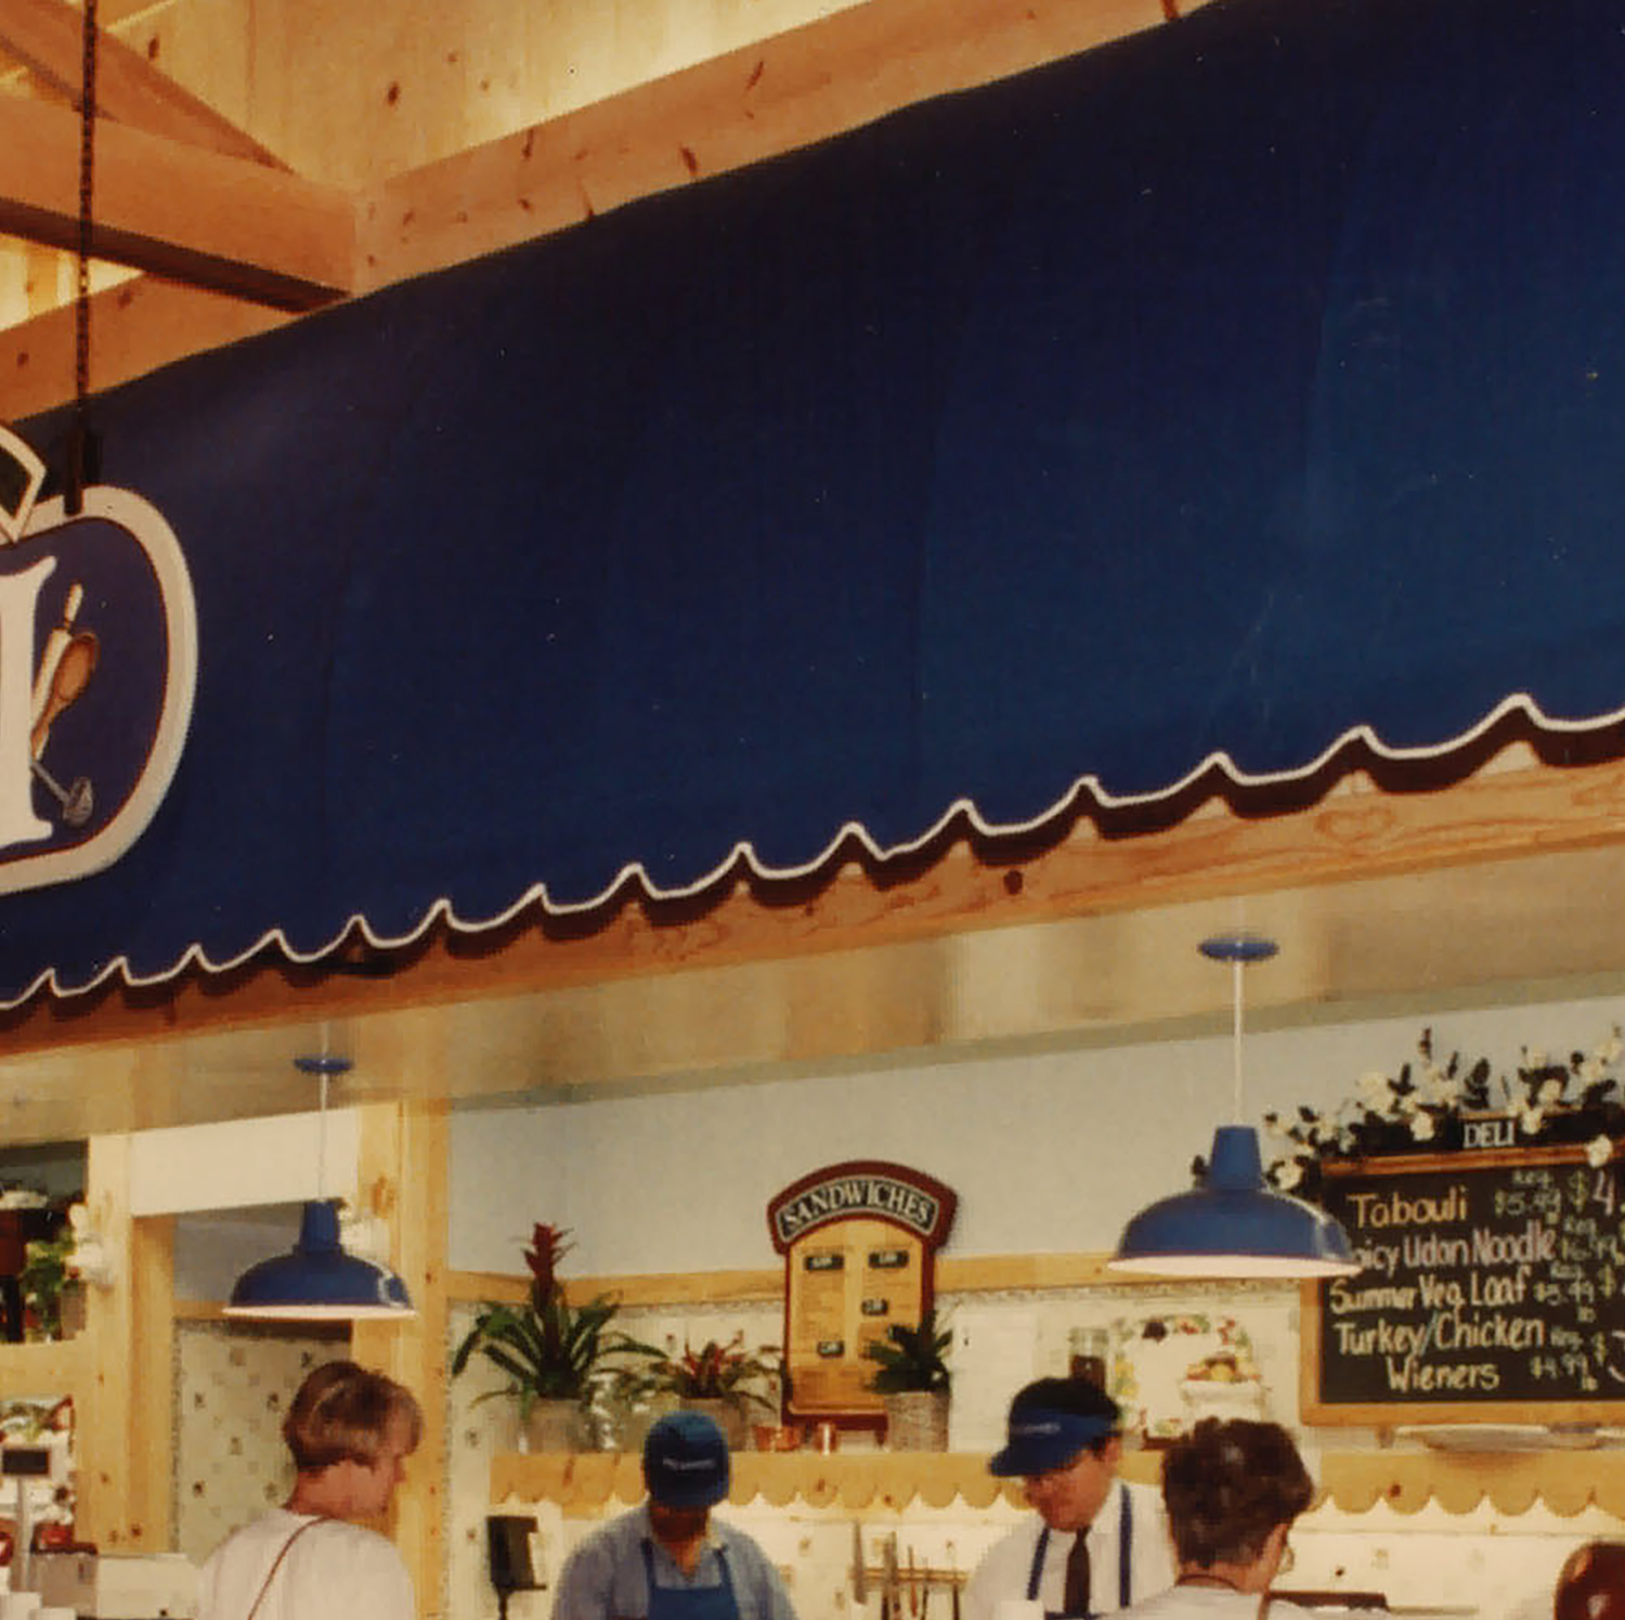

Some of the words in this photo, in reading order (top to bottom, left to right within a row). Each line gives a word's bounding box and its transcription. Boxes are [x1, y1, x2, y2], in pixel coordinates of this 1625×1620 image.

[1463, 1120, 1515, 1148] DELI
[783, 1178, 931, 1227] SANDWICHES
[1345, 1186, 1468, 1229] Tabouli
[1403, 1233, 1468, 1268] Udon
[1473, 1219, 1557, 1267] Noodle
[1330, 1278, 1417, 1314] Summer
[1471, 1264, 1533, 1306] Loaf
[1387, 1354, 1501, 1393] Wieners
